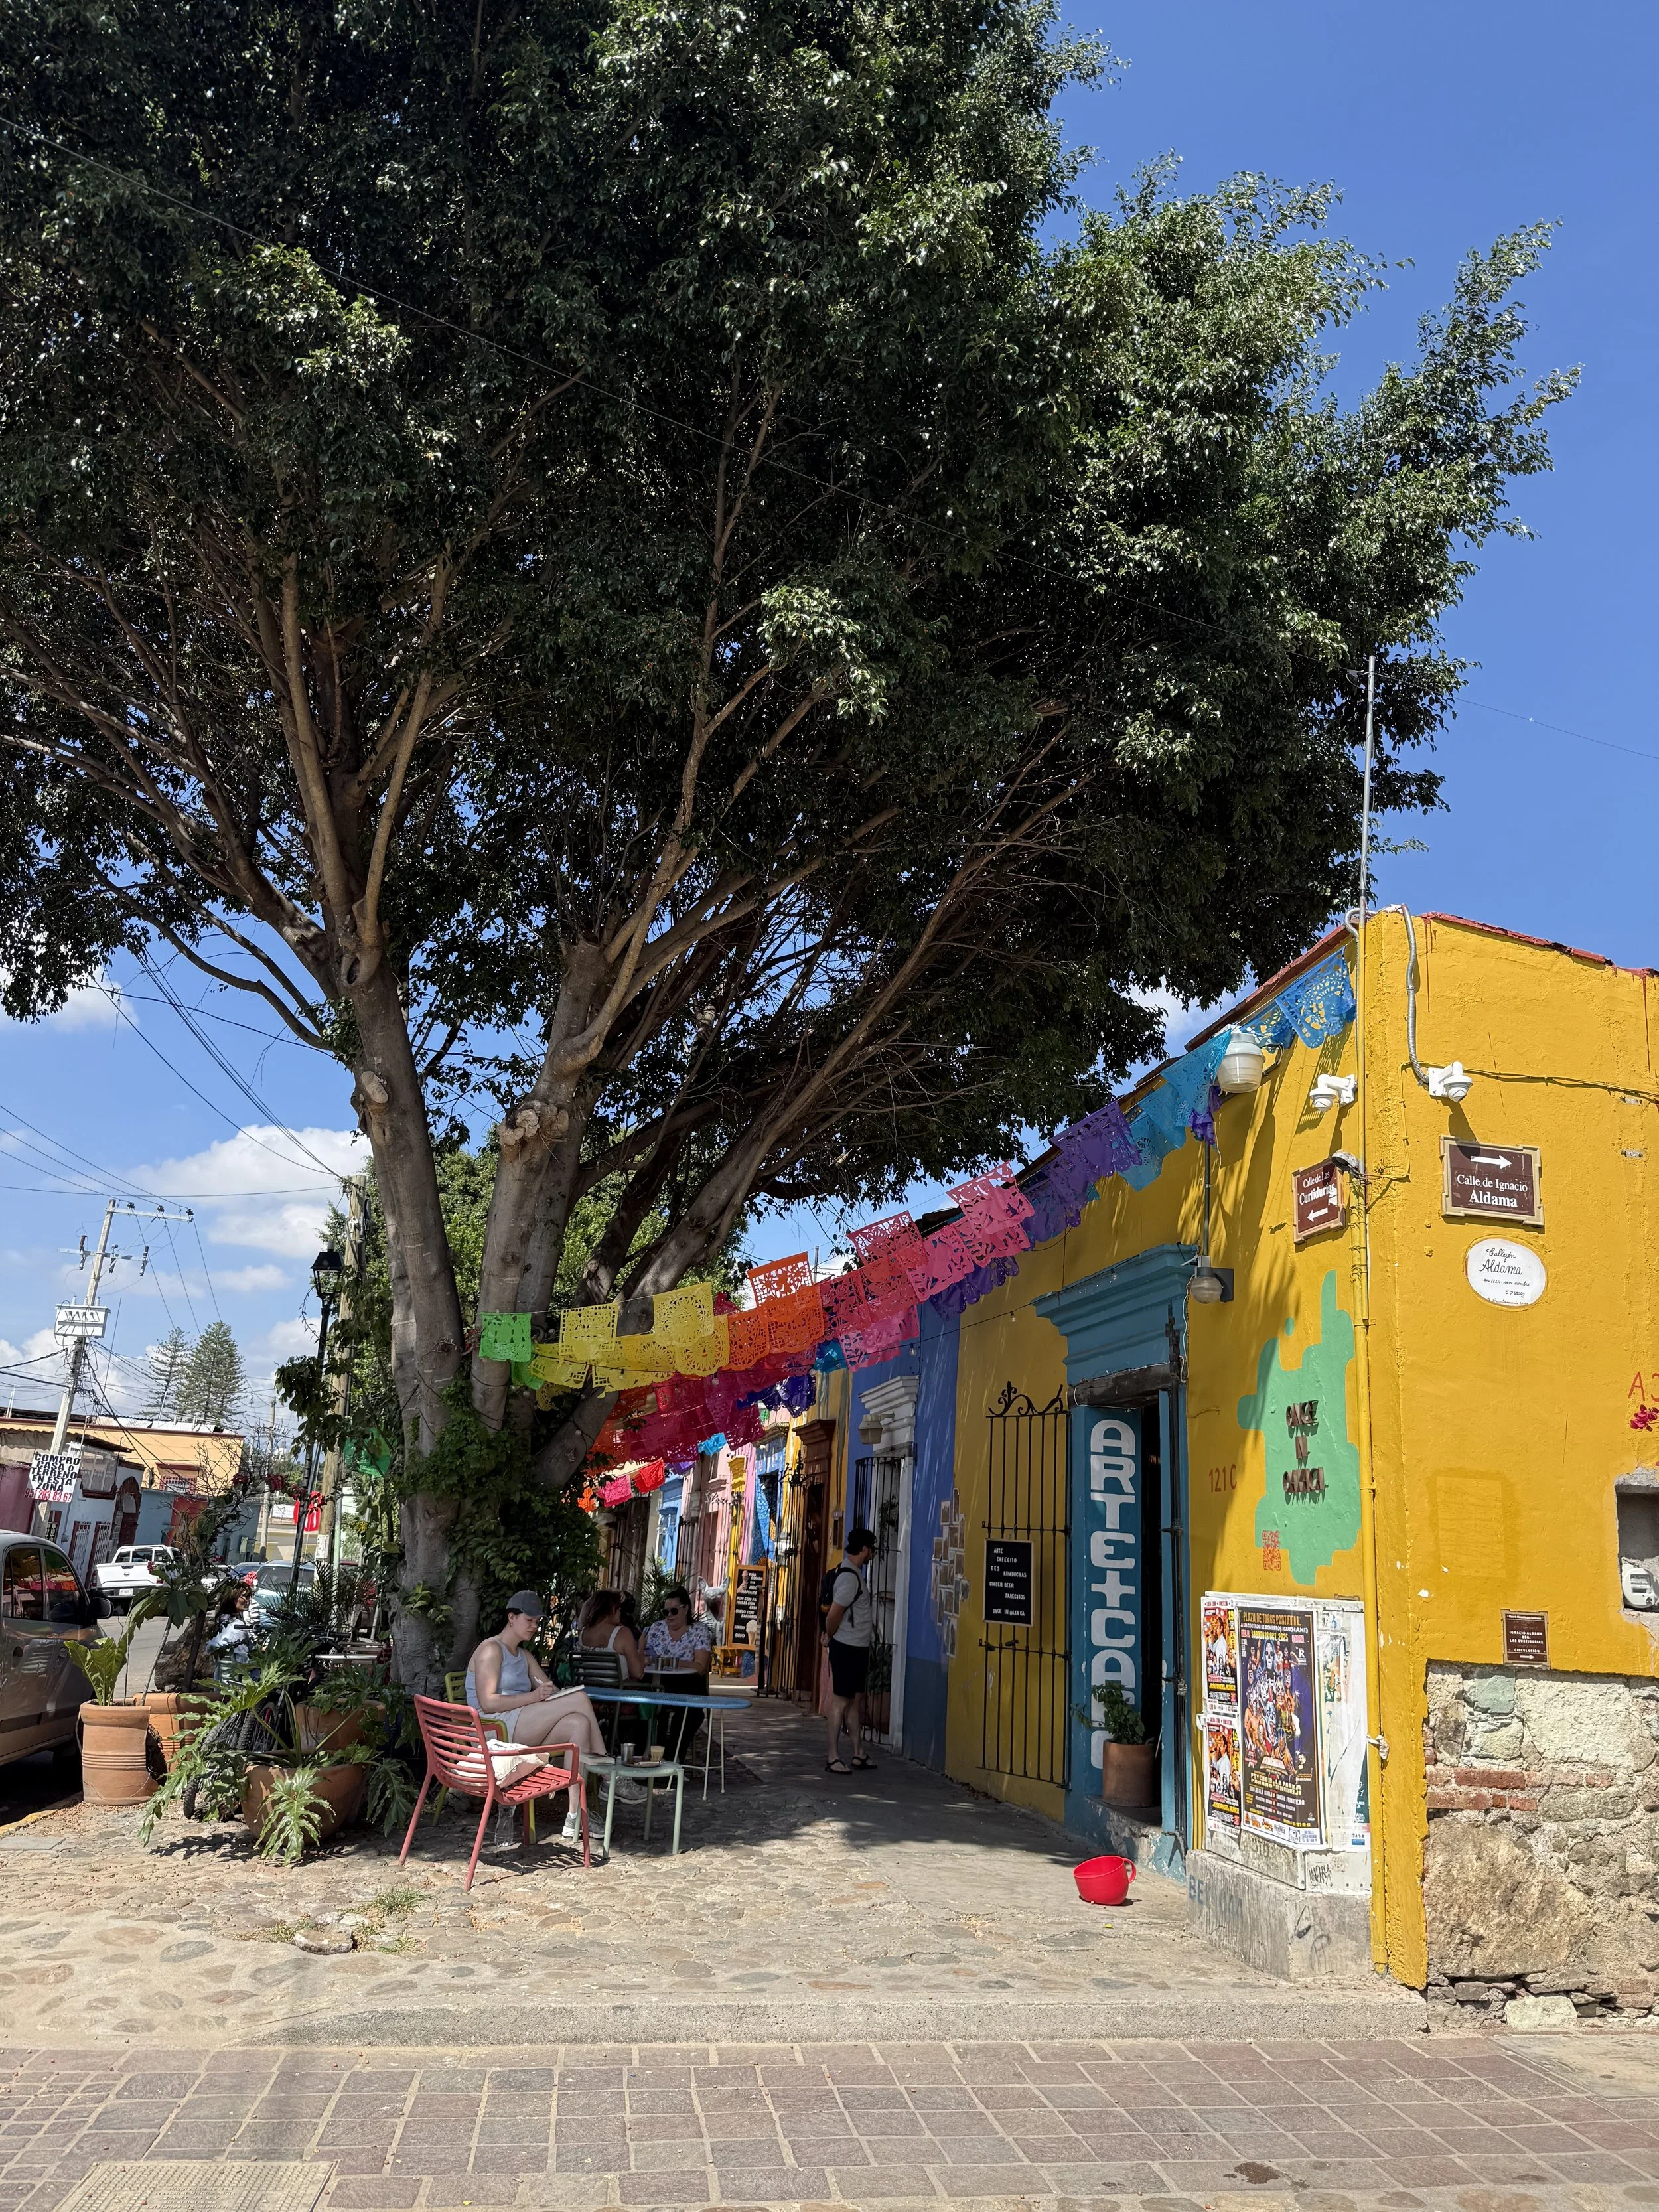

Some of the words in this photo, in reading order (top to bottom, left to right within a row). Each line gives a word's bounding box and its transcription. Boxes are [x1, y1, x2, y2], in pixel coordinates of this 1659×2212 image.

[1303, 1177, 1315, 1188] Calle
[1315, 1174, 1321, 1183] de
[1457, 1175, 1480, 1186] Calle
[1482, 1178, 1493, 1188] de
[1495, 1179, 1528, 1192] Ignacio
[1299, 1183, 1334, 1205] Curtidurías
[1469, 1189, 1518, 1207] Aldama
[1486, 1248, 1516, 1262] Callejón
[1479, 1258, 1522, 1274] Aldama
[34, 1453, 81, 1465] COMPRO
[36, 1461, 64, 1471] CASA
[31, 1467, 78, 1479] TERRENO
[36, 1482, 64, 1492] ZONA
[48, 1477, 72, 1486] ESTA
[25, 1488, 37, 1499] 951
[38, 1489, 51, 1501] 283
[53, 1491, 62, 1502] 83
[1243, 1612, 1256, 1623] PLAZA
[1256, 1613, 1262, 1623] DE
[1262, 1613, 1275, 1625] TOROS
